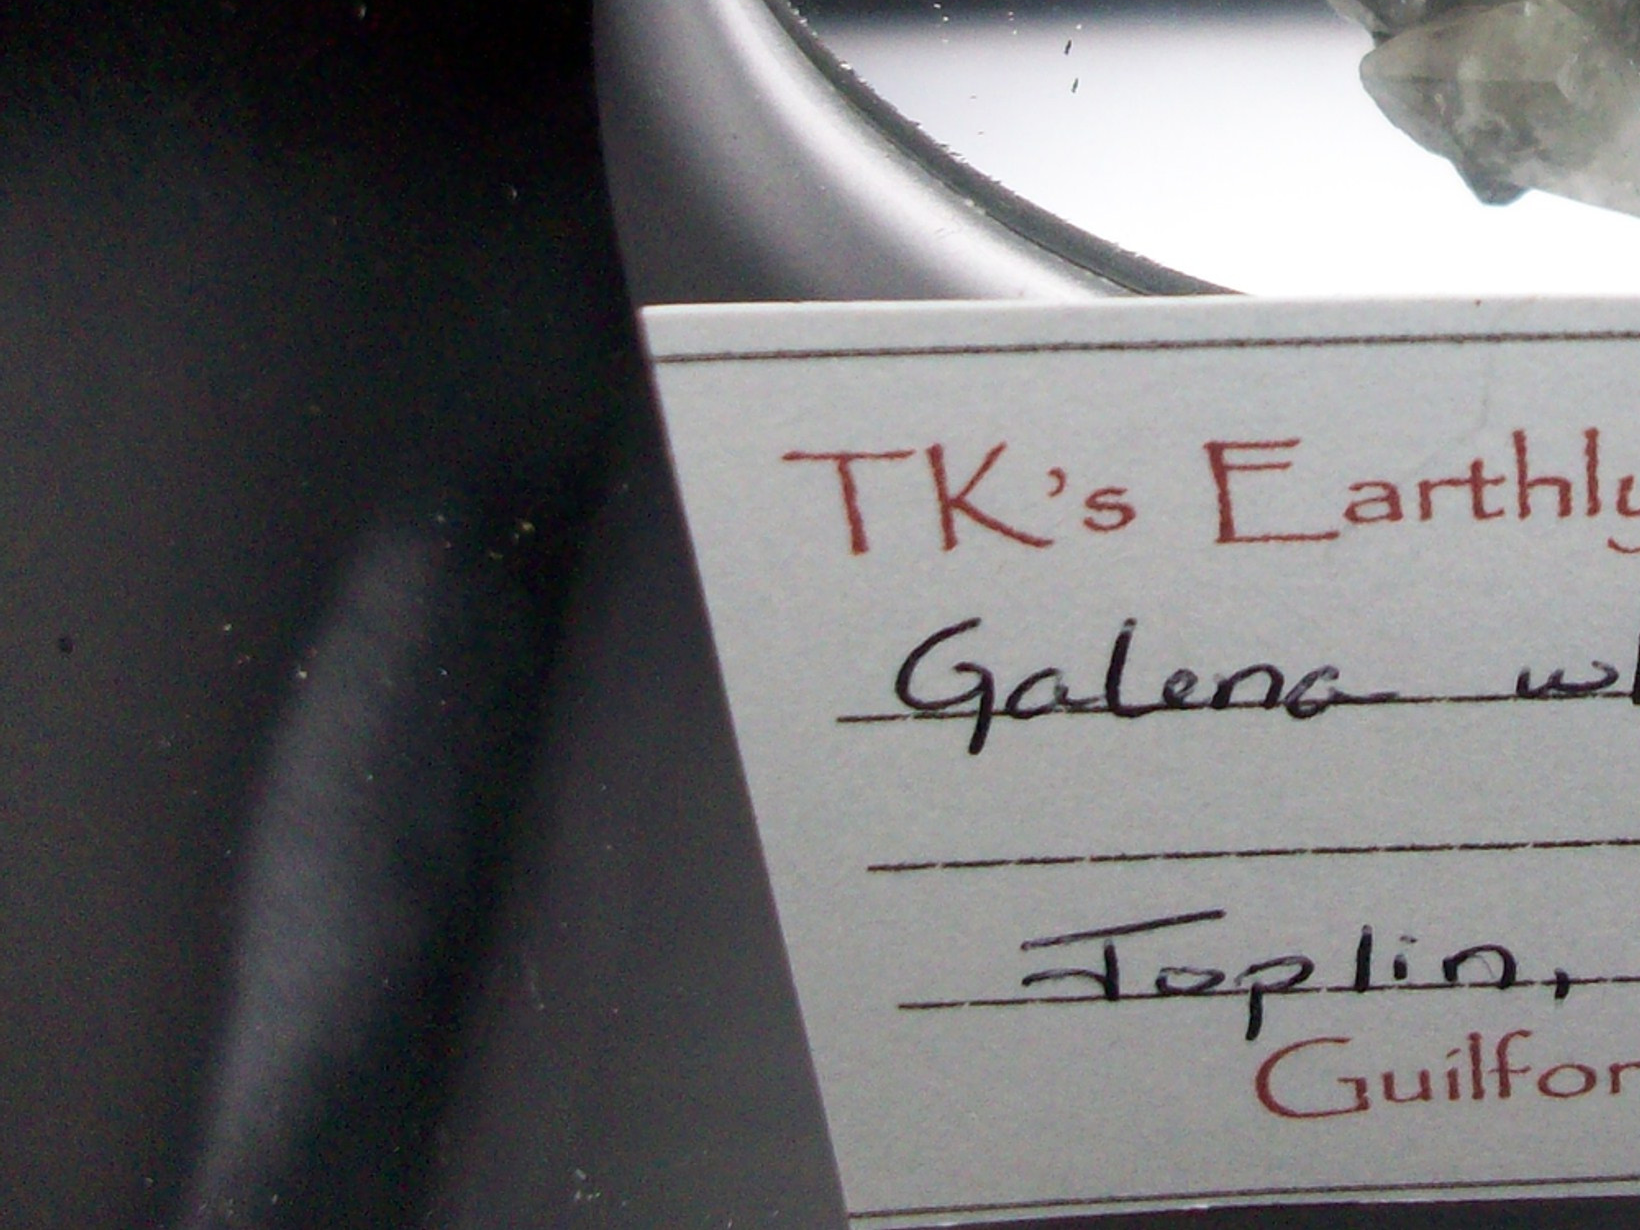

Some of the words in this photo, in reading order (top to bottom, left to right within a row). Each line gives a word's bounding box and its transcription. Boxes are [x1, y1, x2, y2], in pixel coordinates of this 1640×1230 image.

[782, 442, 1136, 555] TK's
[894, 617, 1396, 756] Galena
[1020, 909, 1572, 1042] Joplin,
